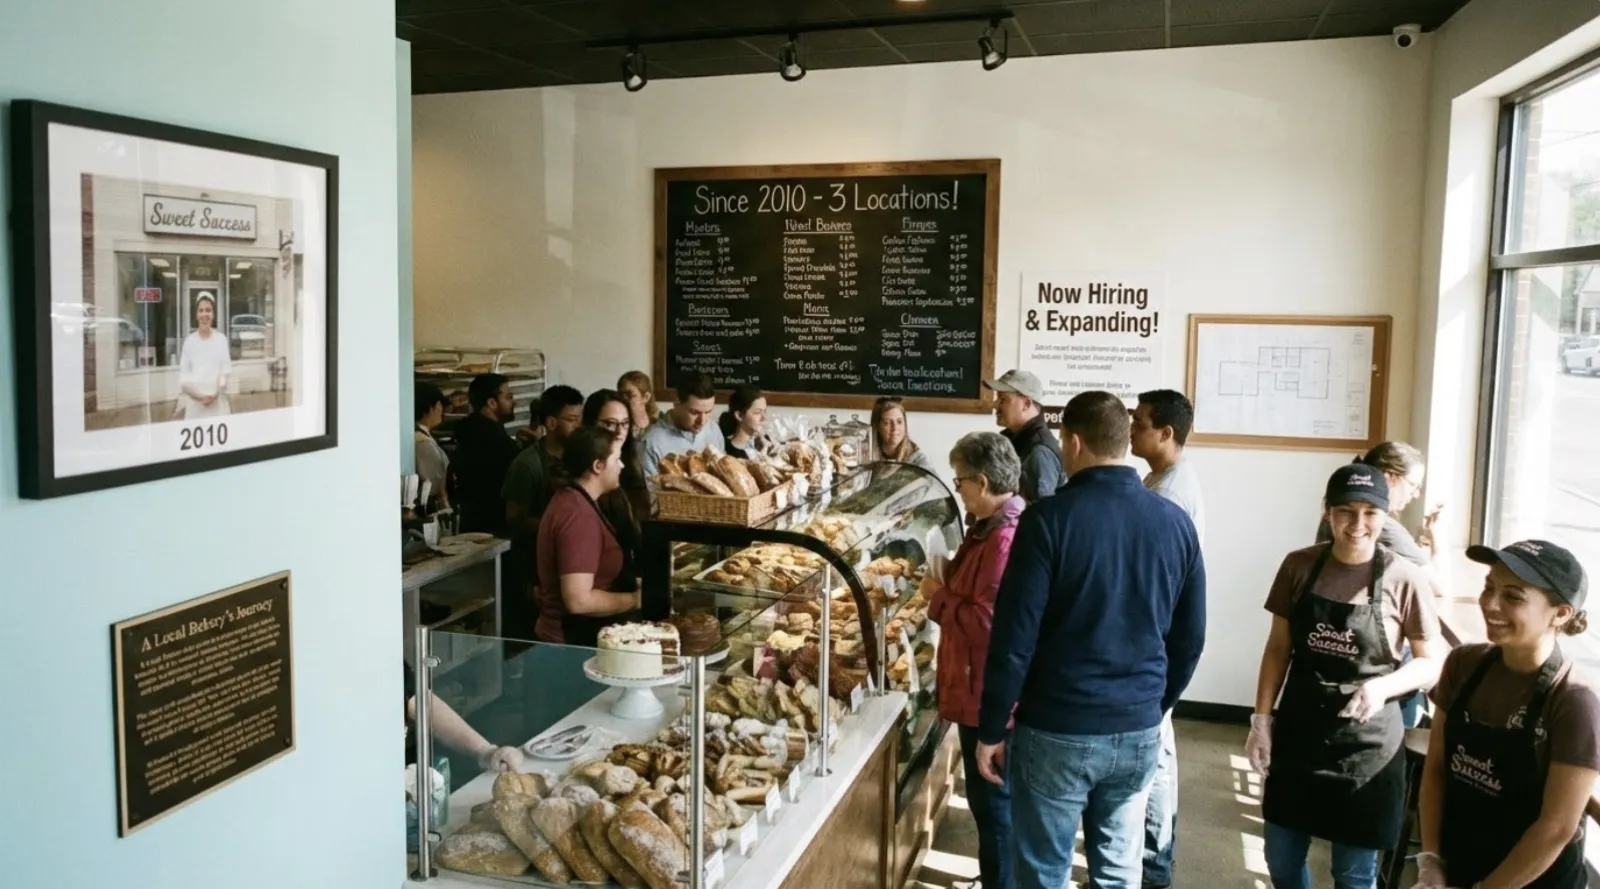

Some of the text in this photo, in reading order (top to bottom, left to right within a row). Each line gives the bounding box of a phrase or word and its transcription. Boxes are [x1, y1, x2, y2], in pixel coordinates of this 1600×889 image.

[694, 185, 749, 215] Since
[758, 184, 806, 213] 2010
[828, 183, 846, 212] 3
[854, 180, 959, 212] Locations!
[150, 202, 196, 228] Sweet
[1038, 282, 1149, 310] Now Hiring
[1025, 309, 1159, 338] & Expanding!
[180, 423, 228, 450] 2010
[141, 637, 152, 653] A
[154, 624, 186, 648] Local
